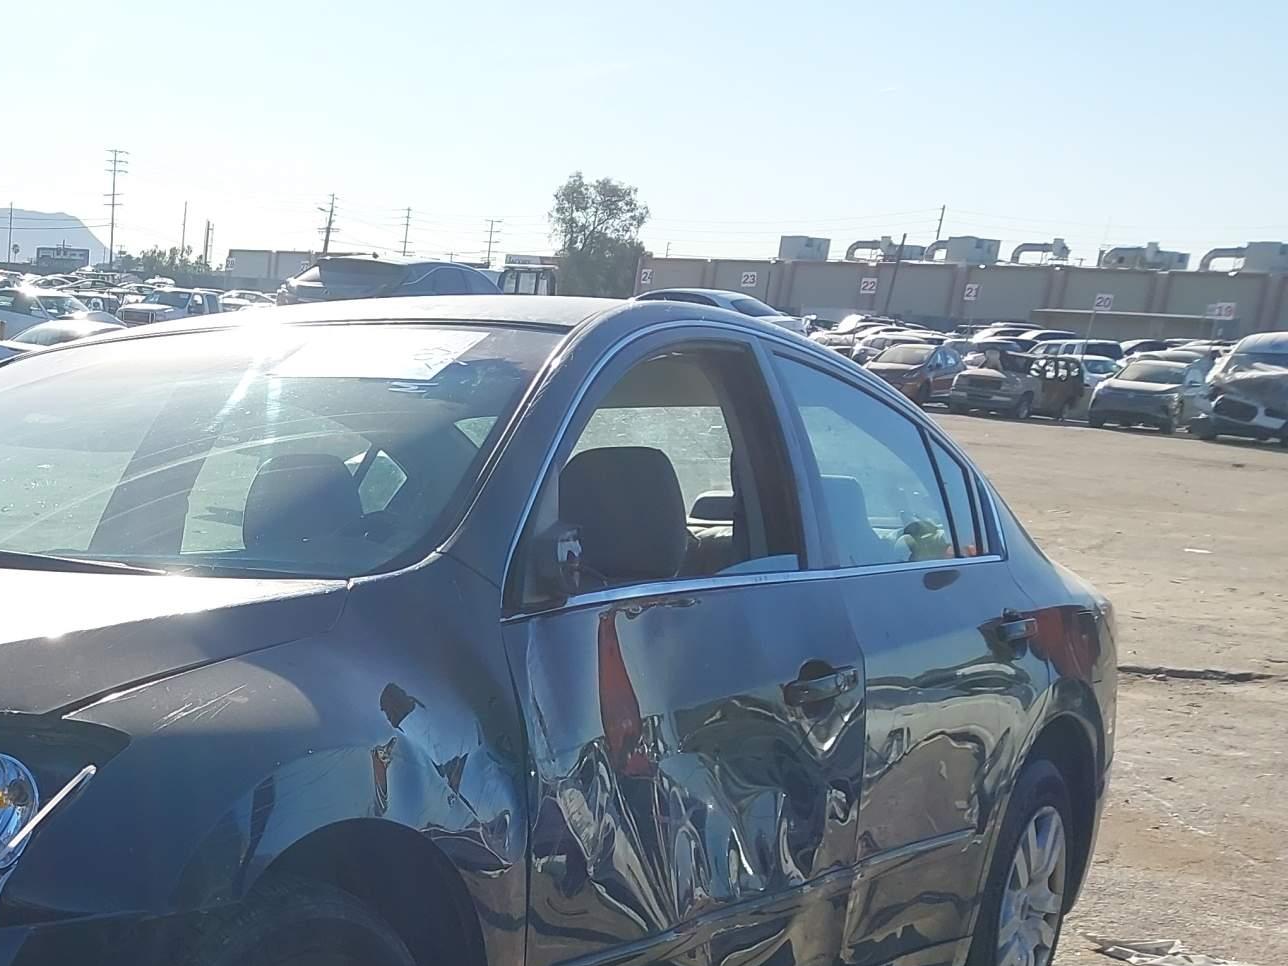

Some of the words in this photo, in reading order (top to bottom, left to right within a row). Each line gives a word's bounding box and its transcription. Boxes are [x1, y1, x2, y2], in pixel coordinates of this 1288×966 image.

[743, 274, 756, 284] 23
[861, 280, 876, 290] 22
[966, 287, 979, 298] 21
[1095, 296, 1112, 308] 20
[1216, 305, 1233, 317] 19
